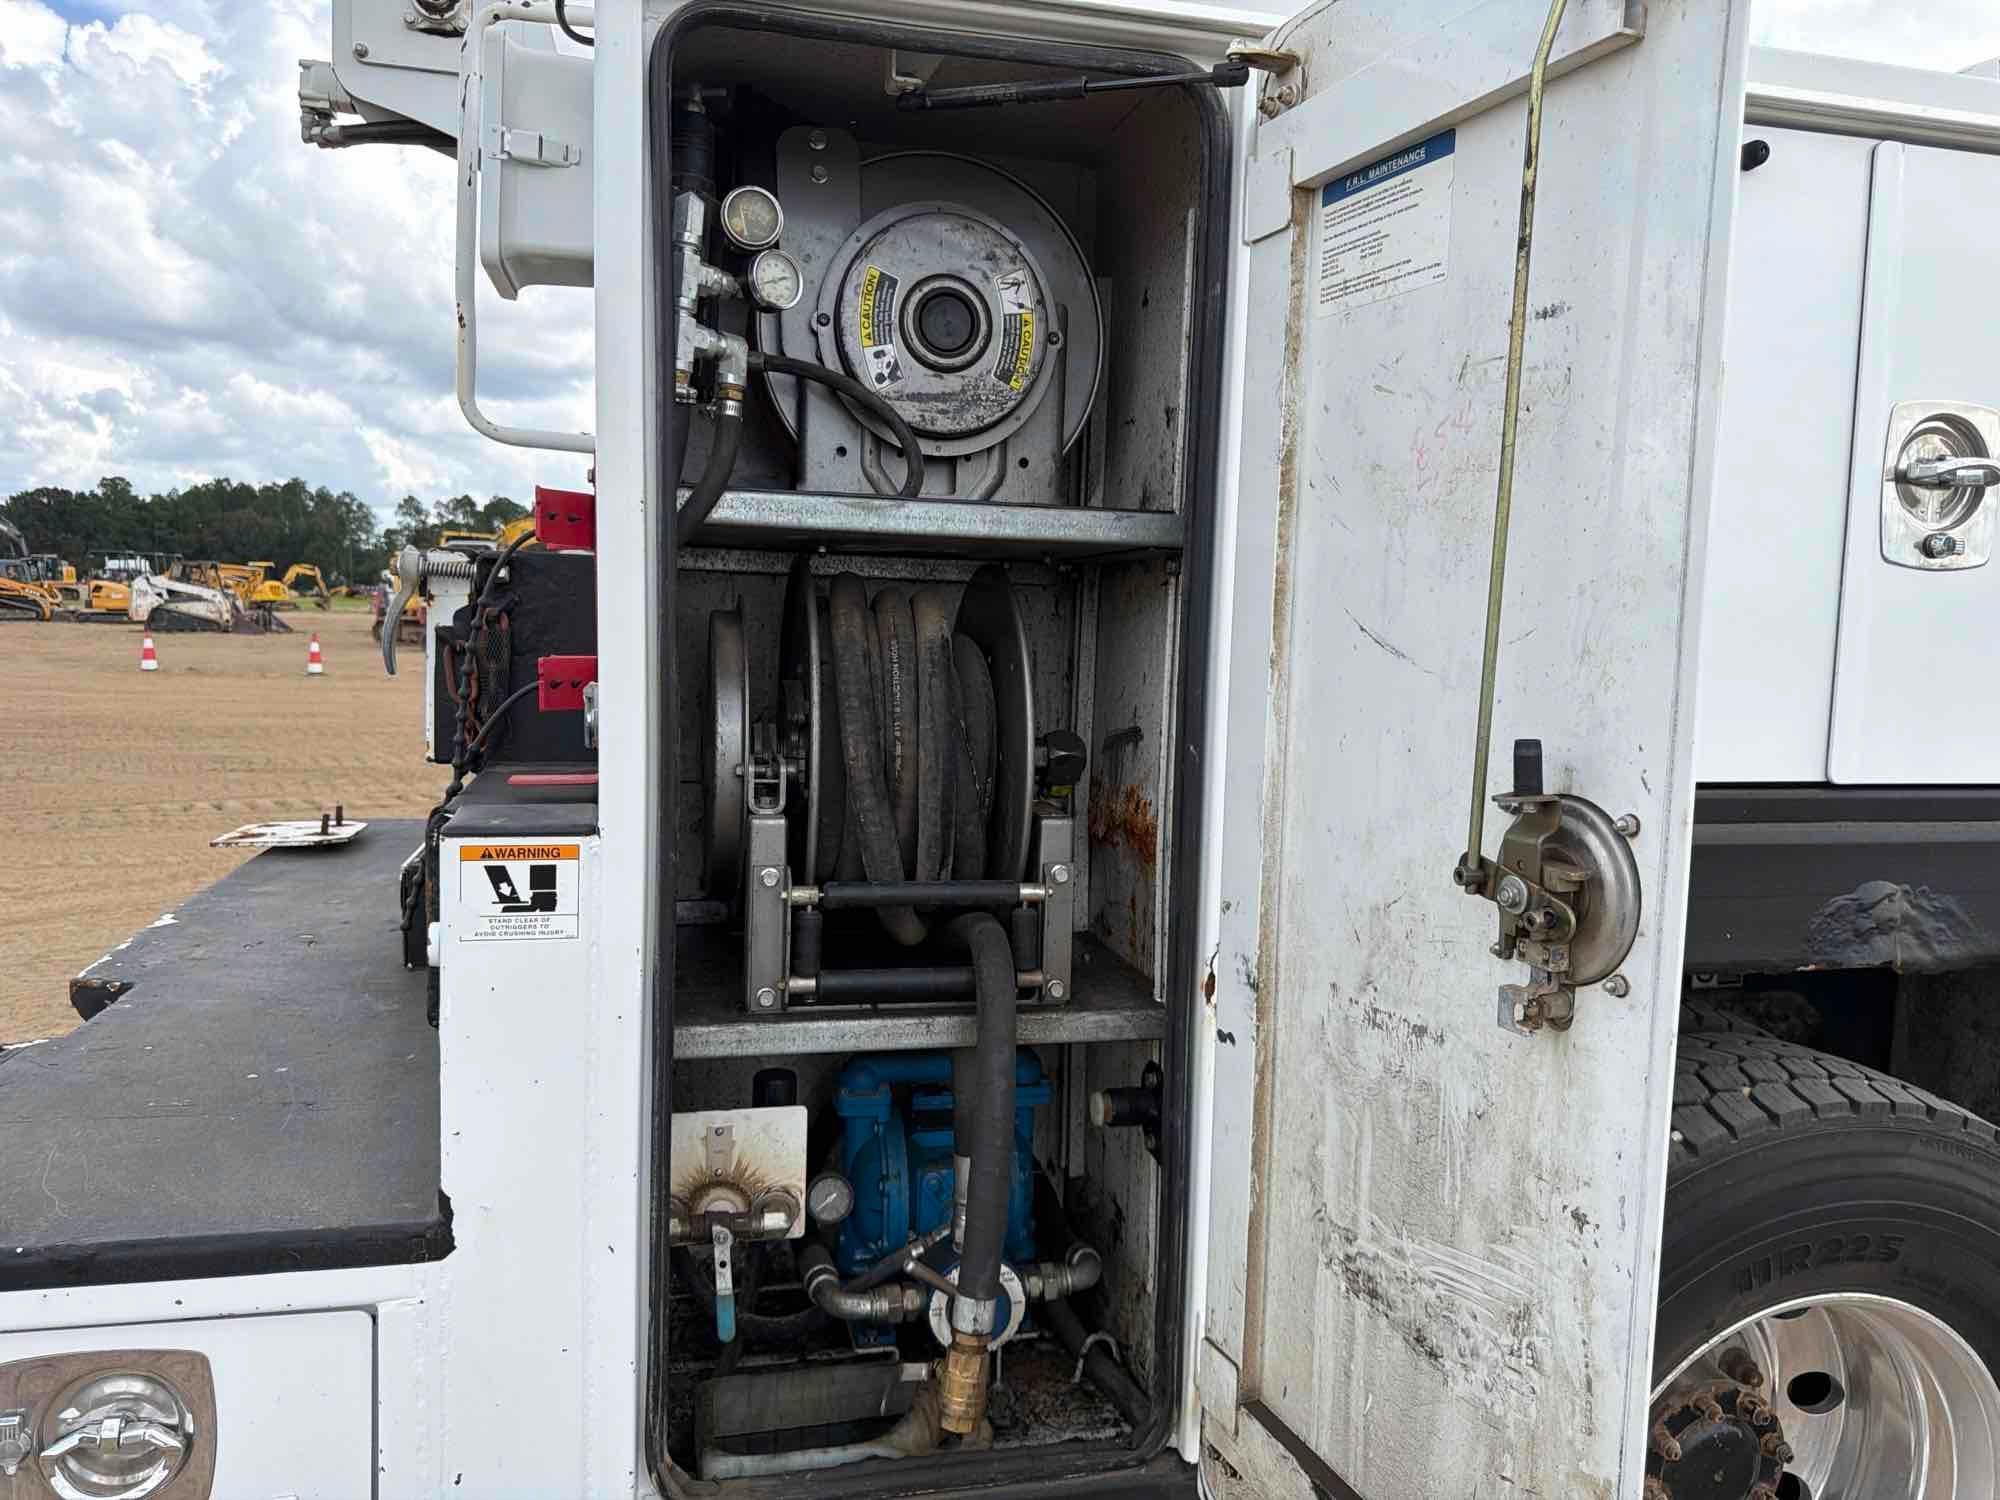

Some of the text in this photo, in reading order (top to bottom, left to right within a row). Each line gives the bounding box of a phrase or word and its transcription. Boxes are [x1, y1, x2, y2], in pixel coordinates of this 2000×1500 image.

[1369, 147, 1426, 177] MAINTENANCE
[862, 273, 877, 330] CAUTION
[496, 847, 560, 859] WARNING
